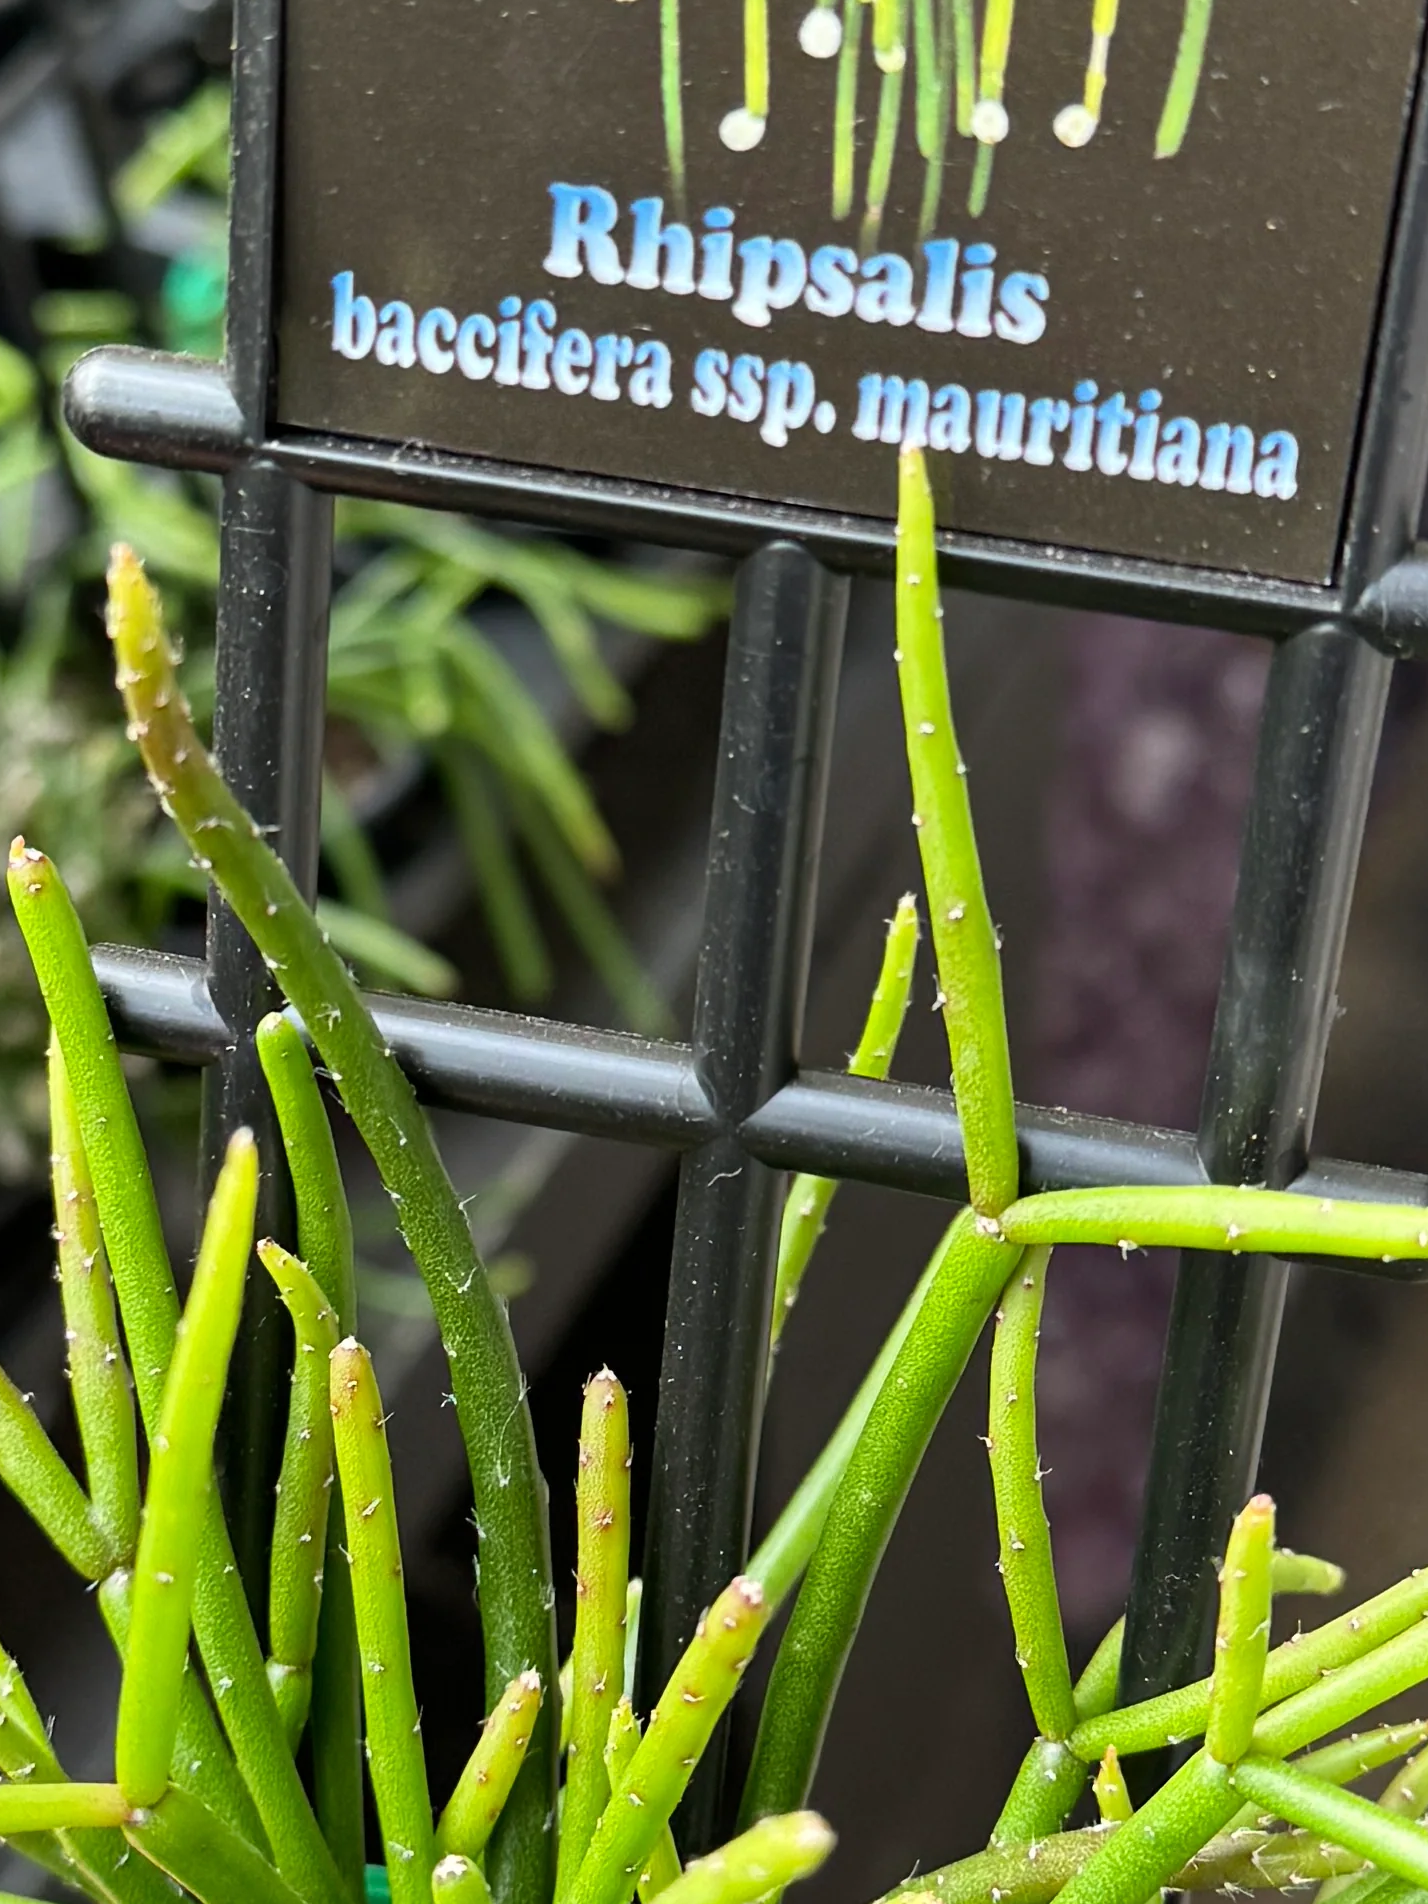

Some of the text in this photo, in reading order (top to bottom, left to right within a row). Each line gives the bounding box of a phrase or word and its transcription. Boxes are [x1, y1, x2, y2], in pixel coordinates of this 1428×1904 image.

[542, 180, 1050, 344] Rhipsalis
[330, 270, 1300, 501] baccifera ssp. mauritiana
